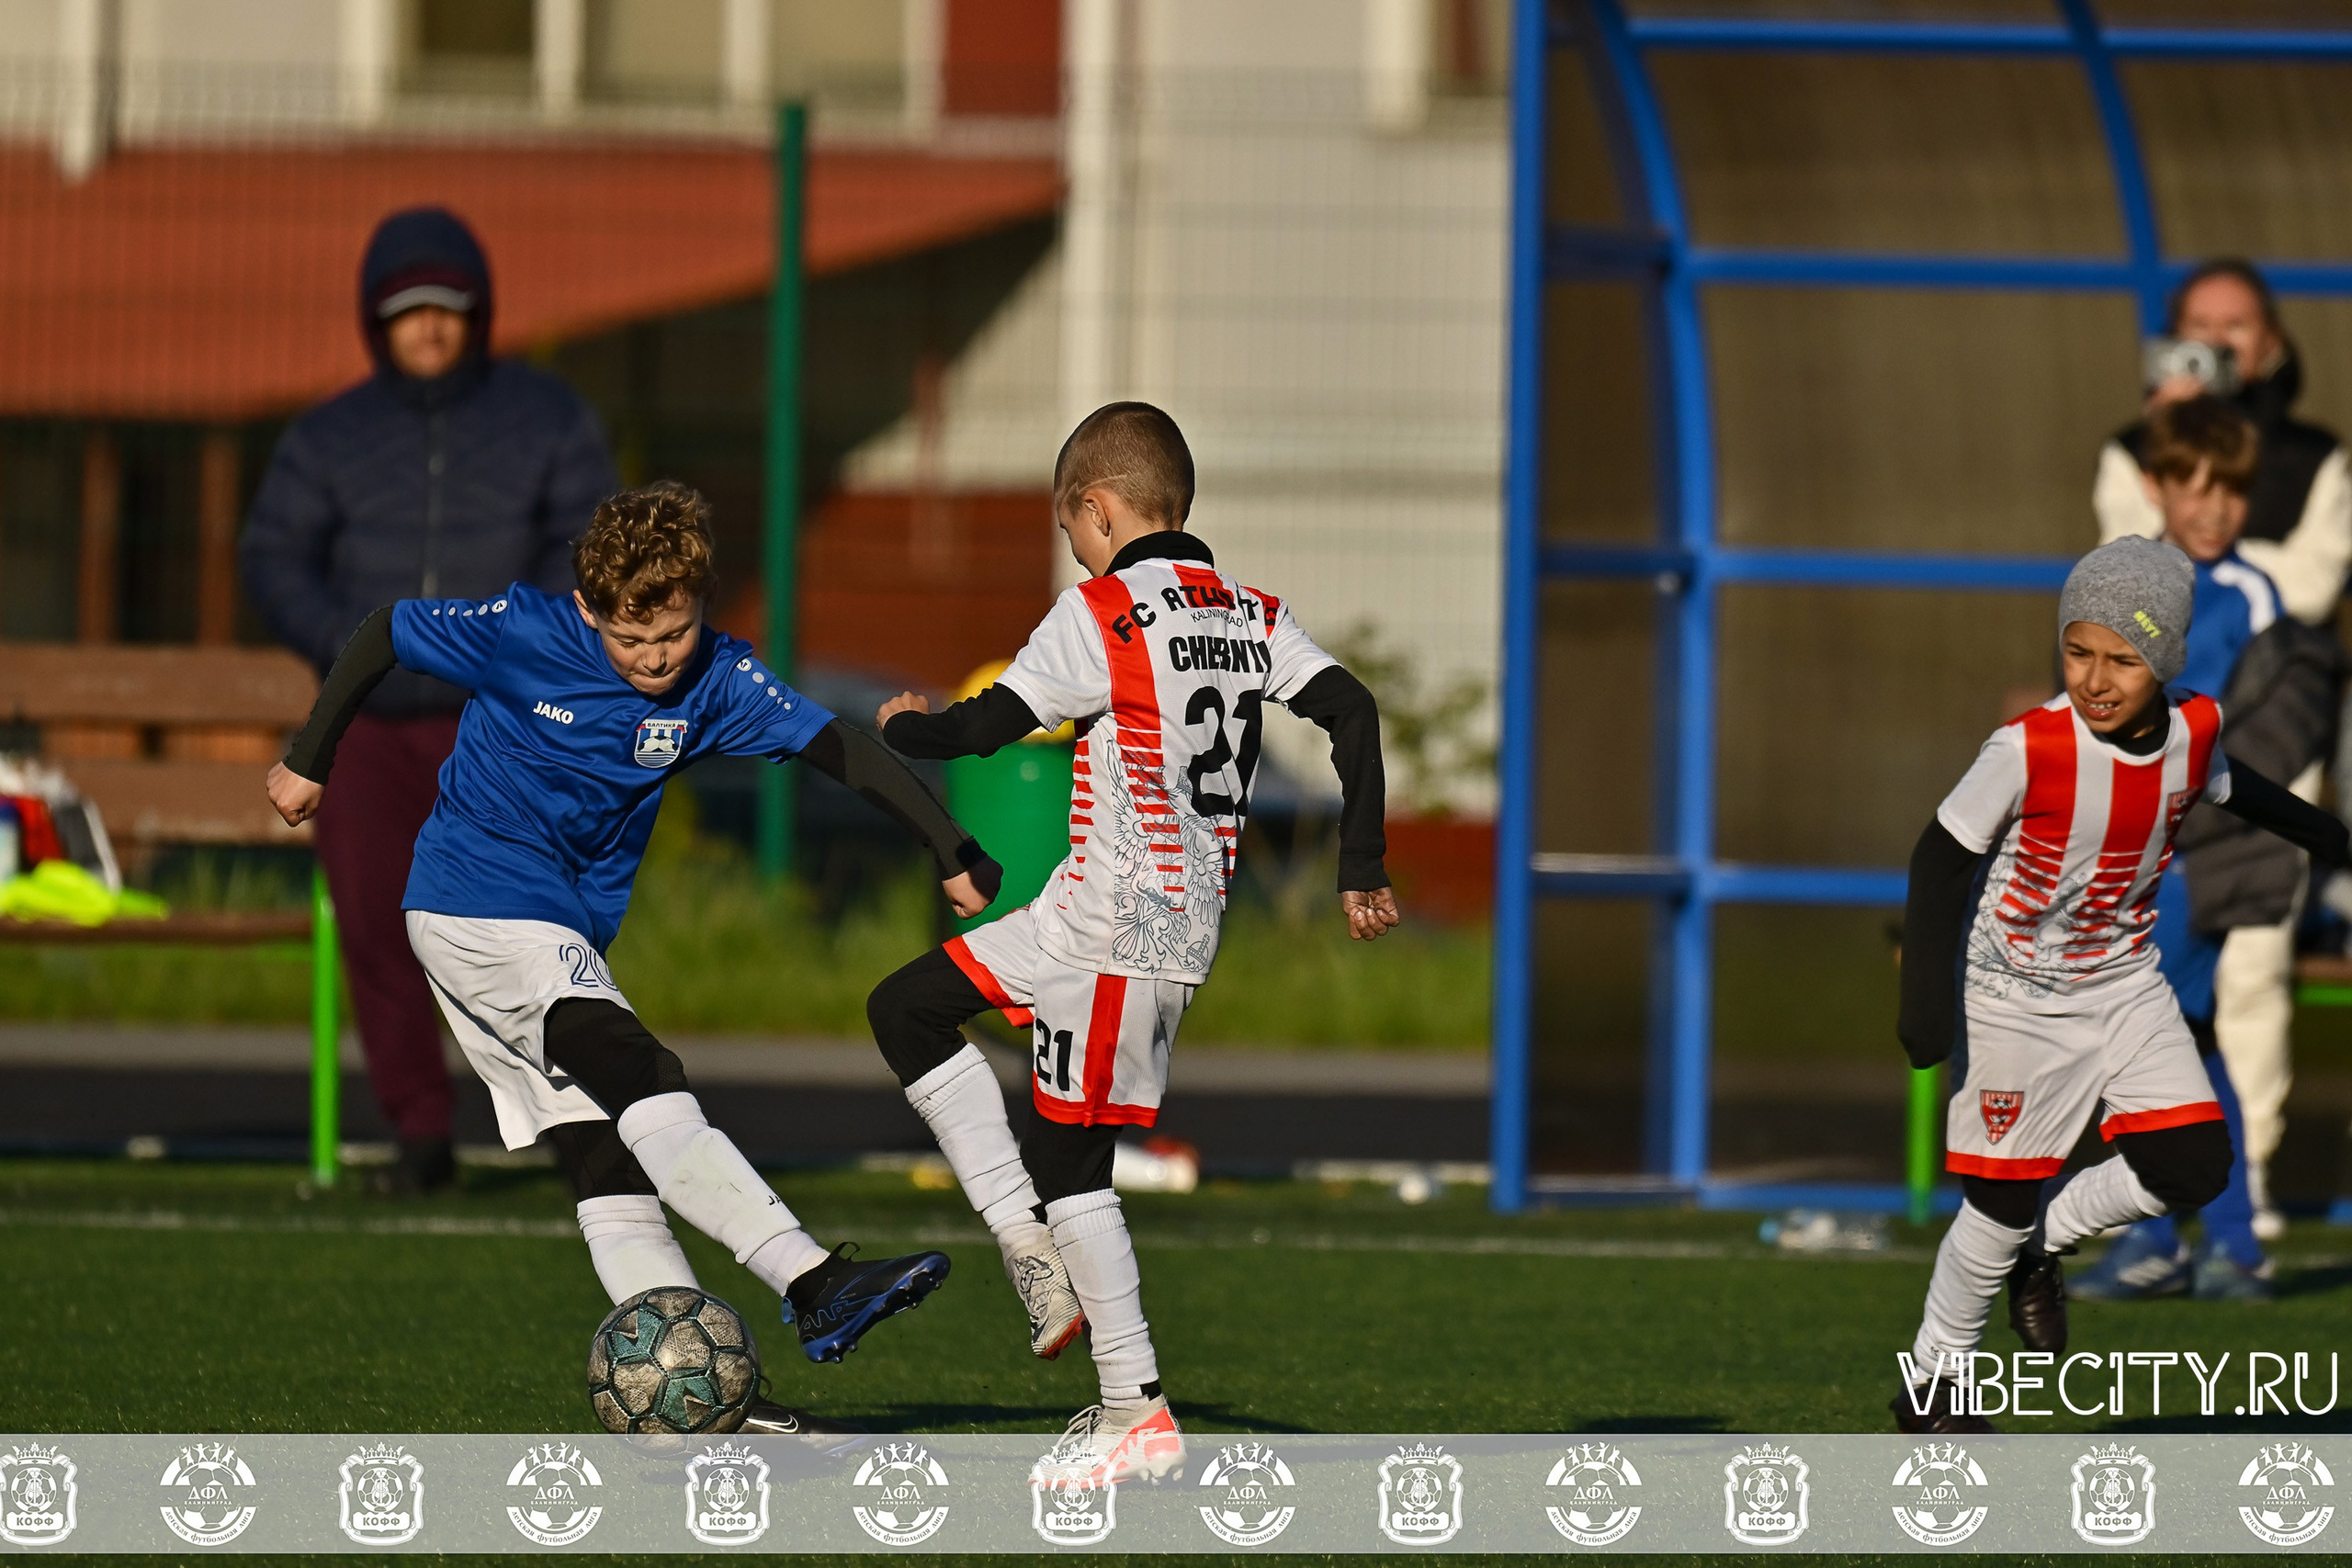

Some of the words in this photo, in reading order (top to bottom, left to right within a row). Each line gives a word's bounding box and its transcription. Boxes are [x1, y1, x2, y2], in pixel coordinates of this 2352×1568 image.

[1112, 602, 1157, 644] FC
[1190, 608, 1243, 627] KALININGRAD
[533, 701, 574, 725] JAKO
[1184, 685, 1264, 818] 21
[1035, 1018, 1073, 1091] 21
